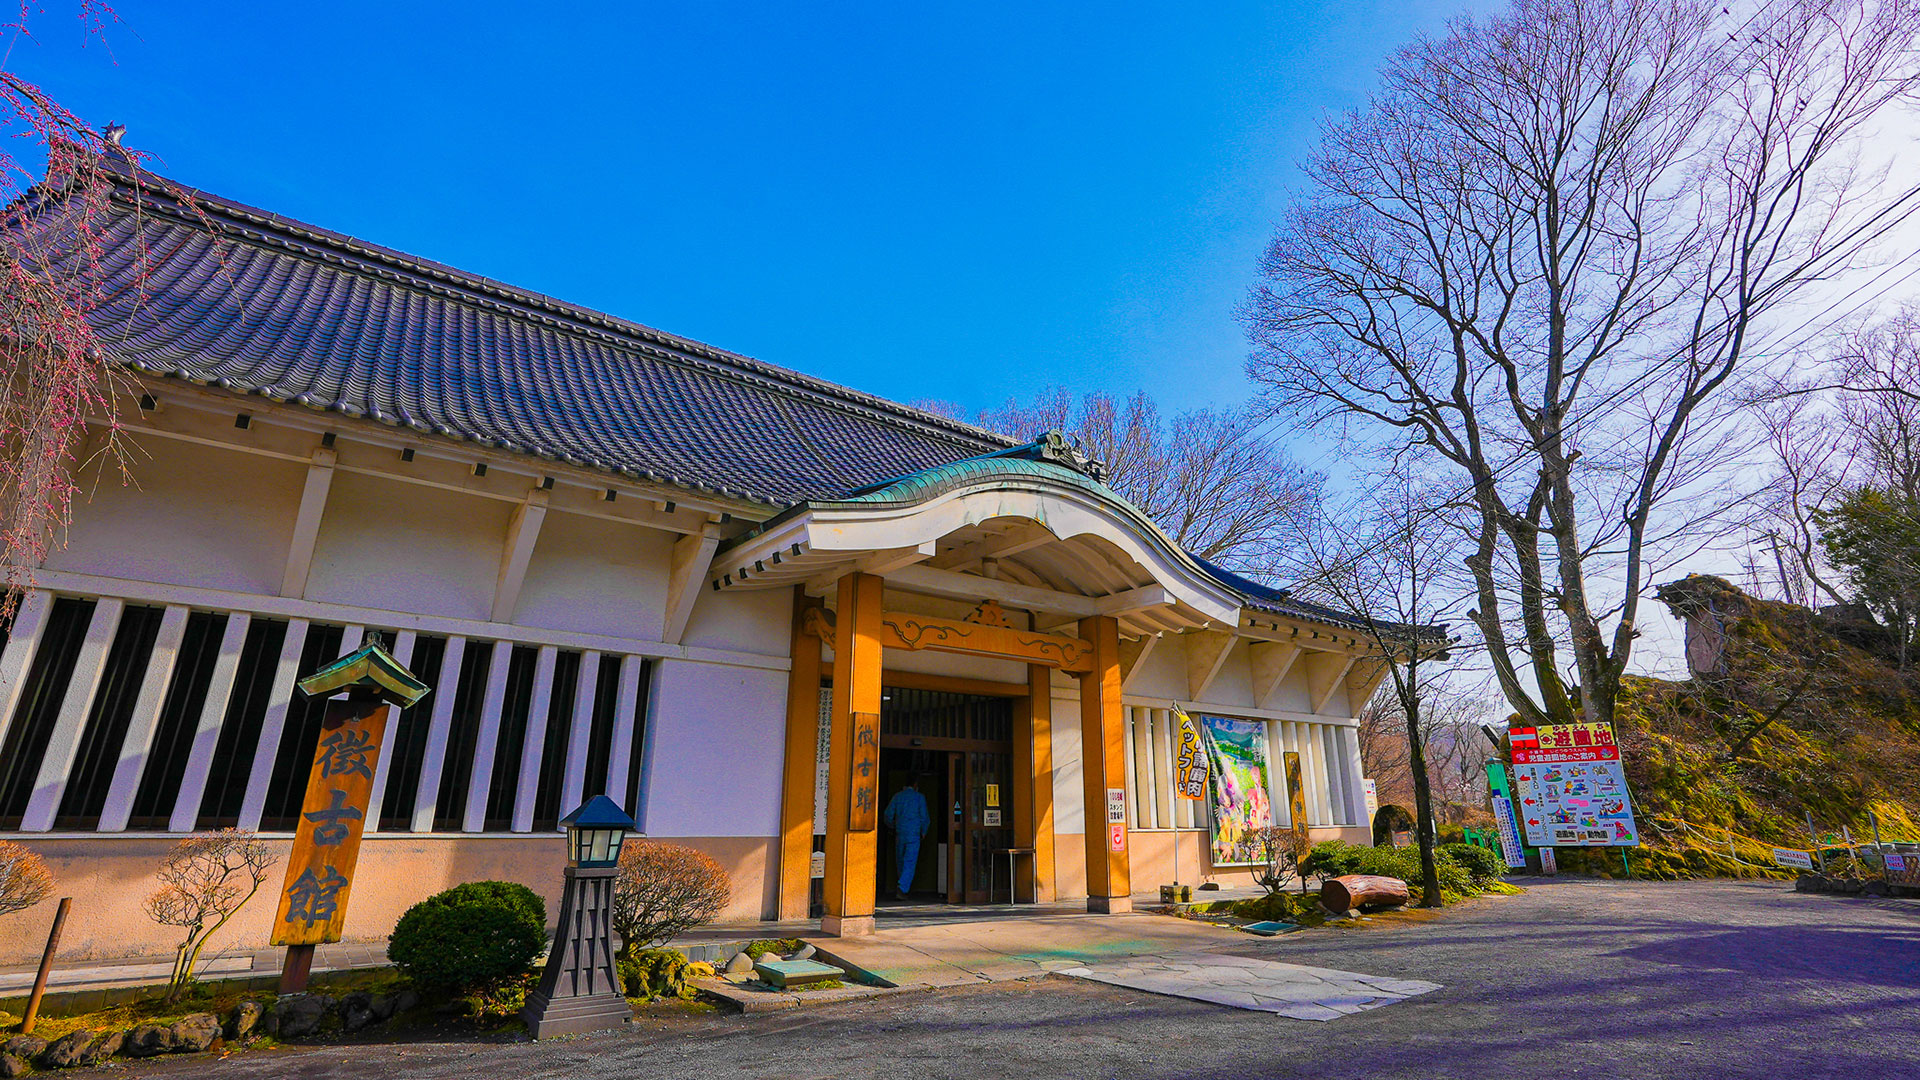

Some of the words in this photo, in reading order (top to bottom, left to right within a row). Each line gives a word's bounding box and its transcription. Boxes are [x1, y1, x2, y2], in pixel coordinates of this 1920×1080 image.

[1552, 729, 1614, 747] 遊園地
[284, 729, 376, 928] 徴古館
